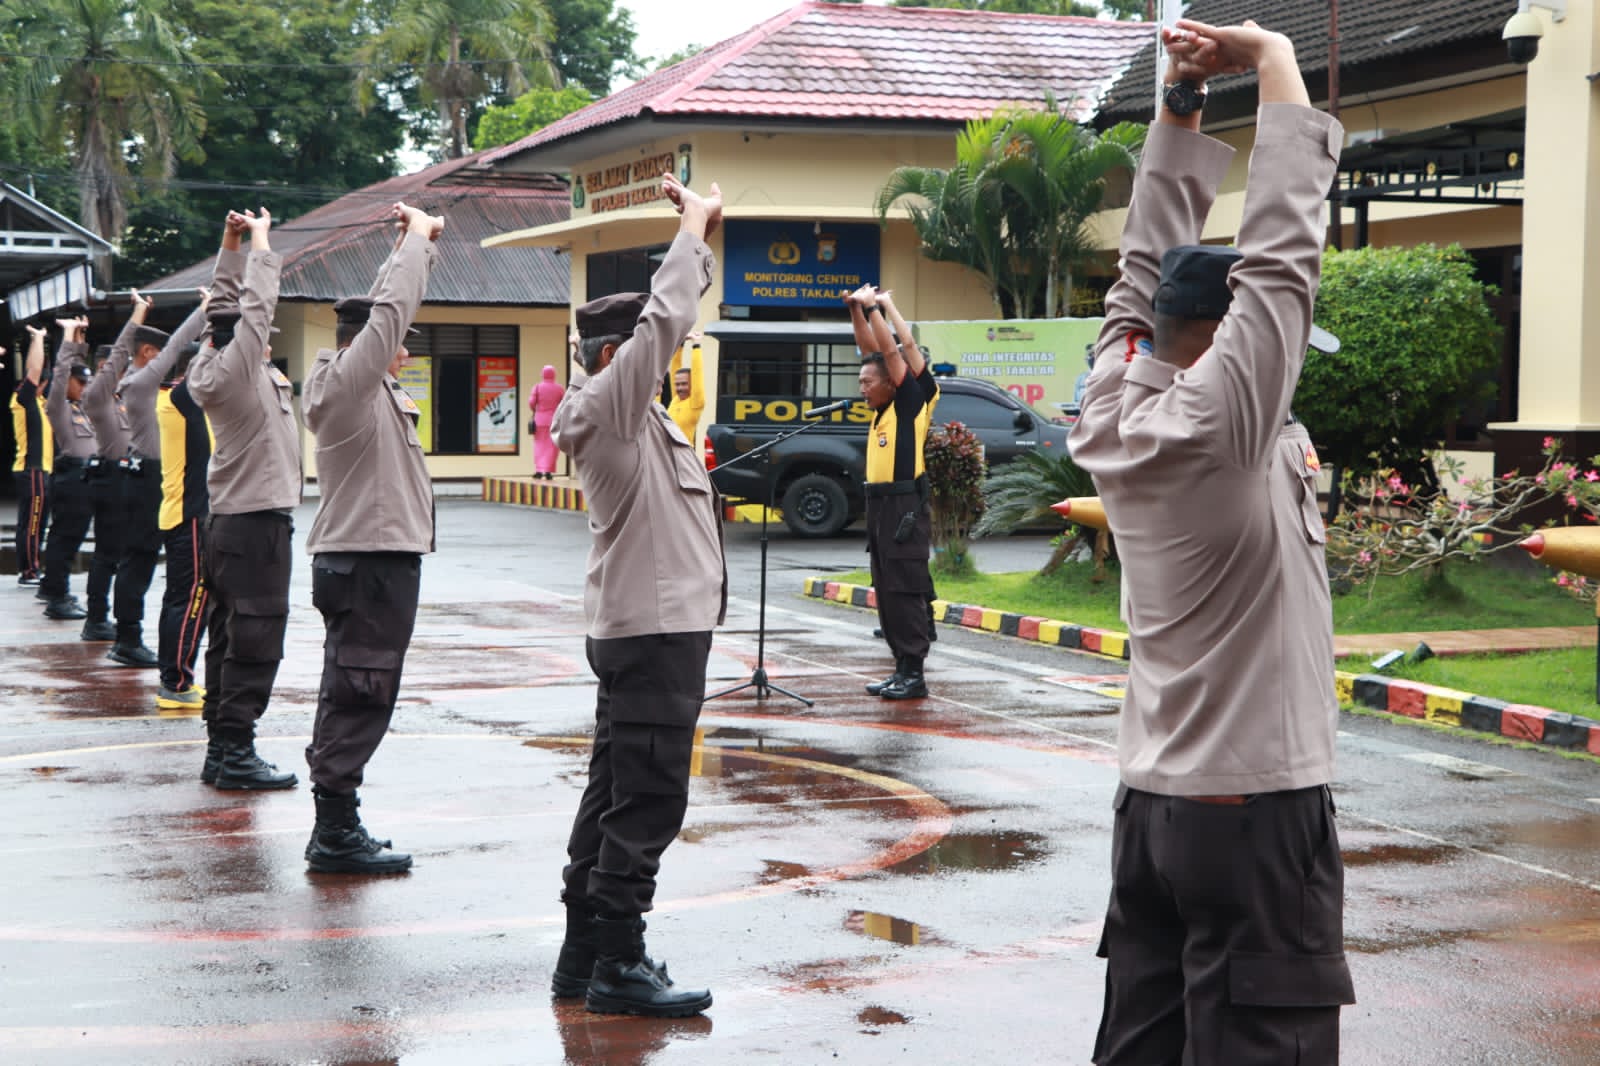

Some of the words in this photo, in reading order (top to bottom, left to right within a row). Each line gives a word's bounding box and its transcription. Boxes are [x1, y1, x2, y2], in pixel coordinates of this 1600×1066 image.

[744, 272, 812, 284] MONITORING
[817, 274, 860, 284] CENTER
[752, 287, 797, 297] POLRES
[961, 352, 989, 363] ZONA
[993, 352, 1056, 362] INTEGRITAS
[961, 365, 1001, 376] POLRES
[1005, 365, 1055, 376] TAKALAR
